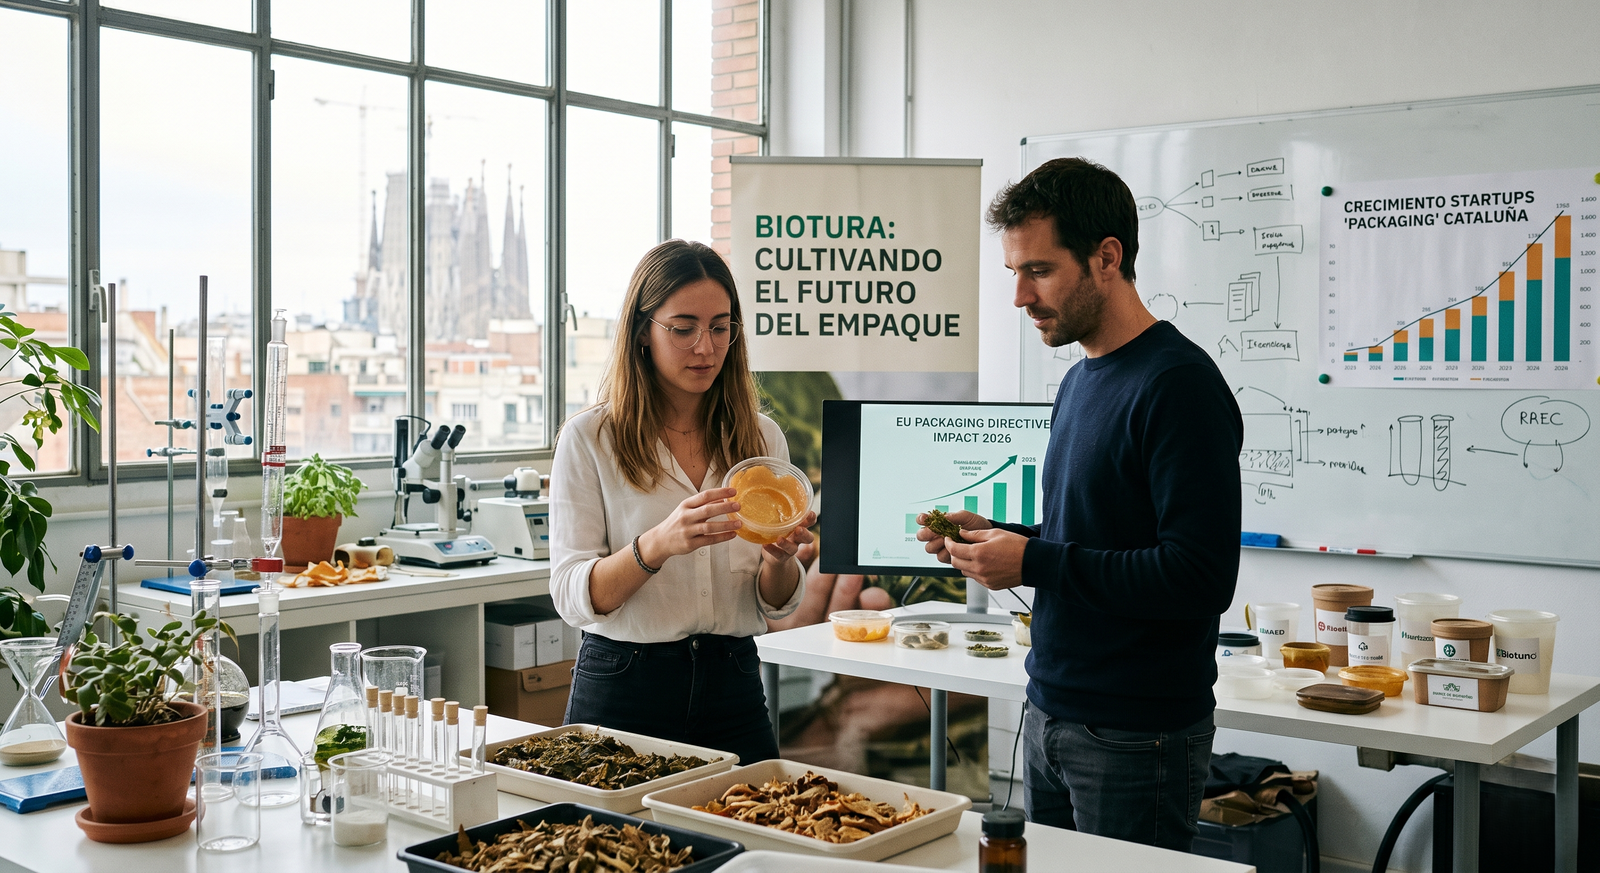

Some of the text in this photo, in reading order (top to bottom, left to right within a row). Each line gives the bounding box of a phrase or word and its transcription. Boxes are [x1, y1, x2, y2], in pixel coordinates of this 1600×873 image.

[1344, 191, 1535, 213] CRECIMIENTO STARTUPS
[756, 215, 895, 239] BIOTURA:
[1344, 206, 1529, 230] 'PACKAGING' CATALUÑA
[755, 248, 942, 272] CULTIVANDO
[756, 280, 916, 304] EL FUTURO
[756, 313, 960, 342] DEL EMPAQUE
[896, 416, 1050, 429] EU PACKAGING DIRECTIVE
[933, 432, 1012, 444] IMPACT 2026
